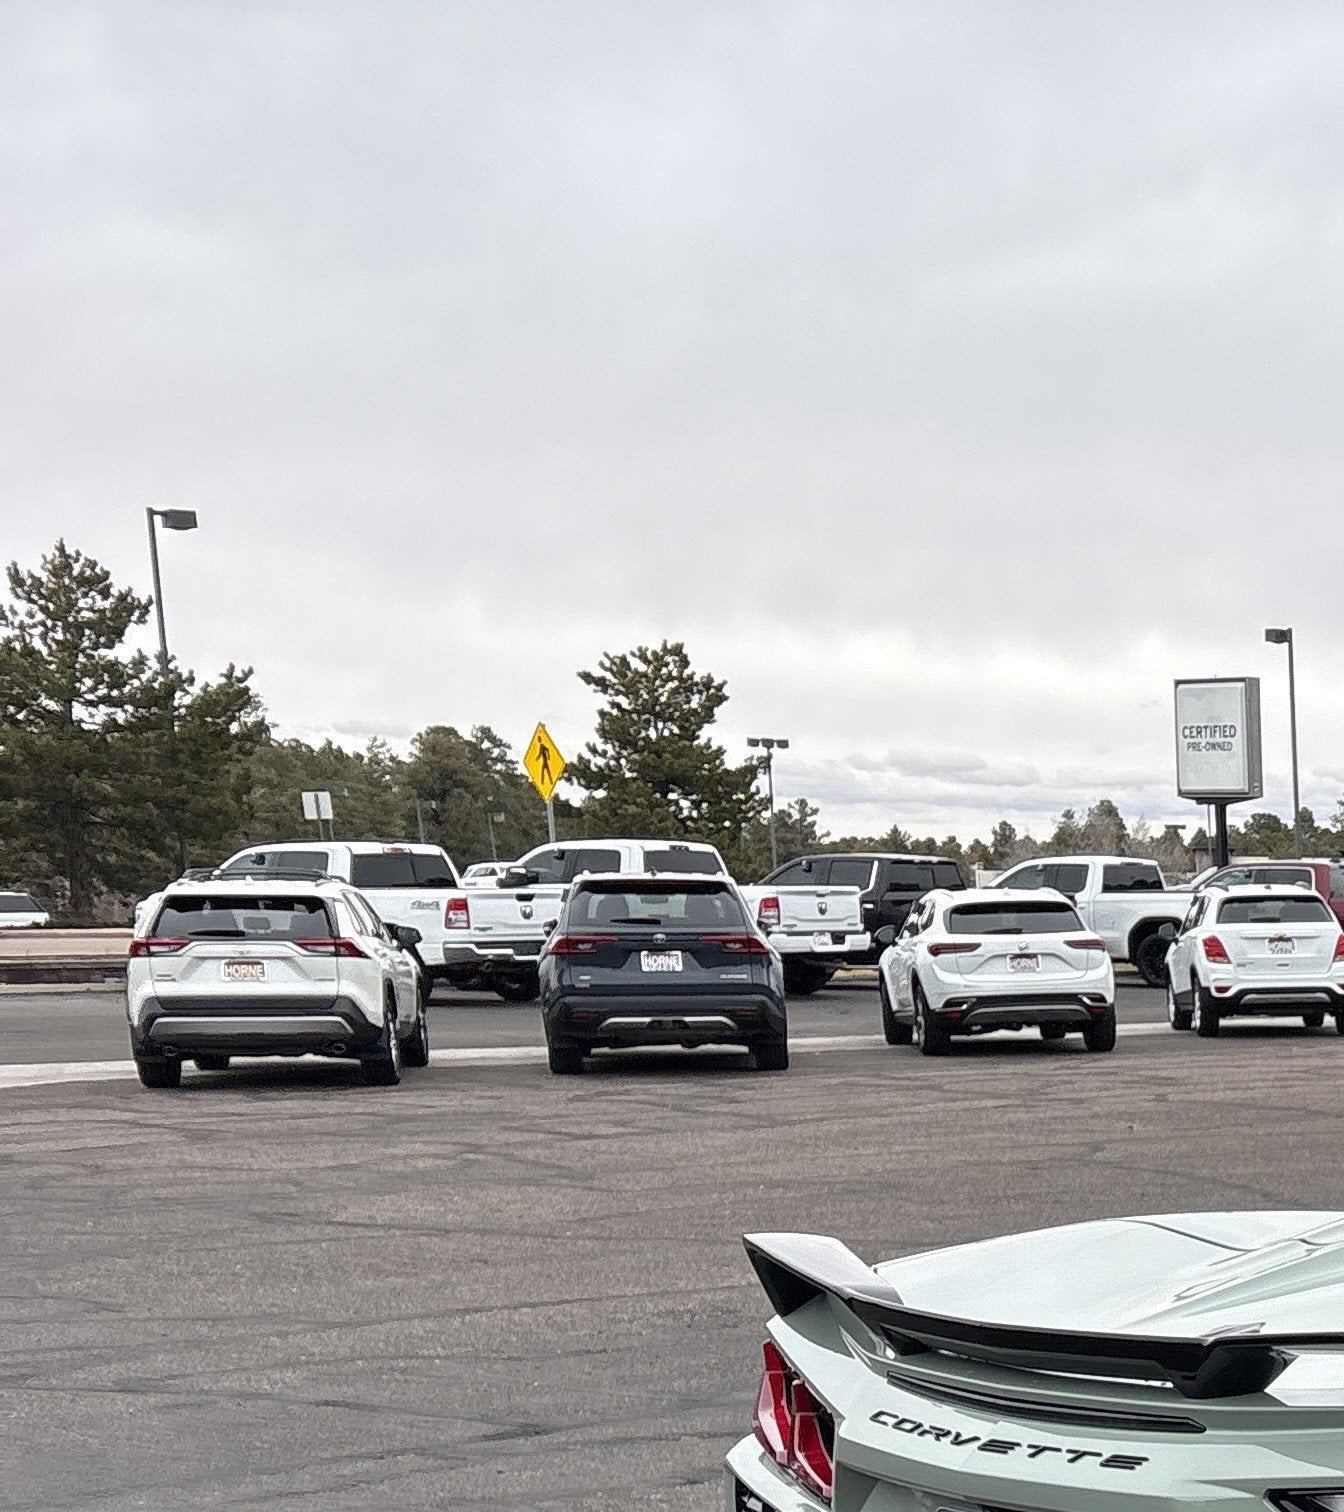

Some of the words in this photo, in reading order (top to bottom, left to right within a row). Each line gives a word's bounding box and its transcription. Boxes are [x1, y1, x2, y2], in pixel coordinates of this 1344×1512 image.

[1182, 724, 1237, 739] CERTIFIED
[1186, 741, 1234, 752] PRE-OWNED
[224, 963, 265, 978] HORNE
[868, 1409, 1150, 1471] CORVETTE
